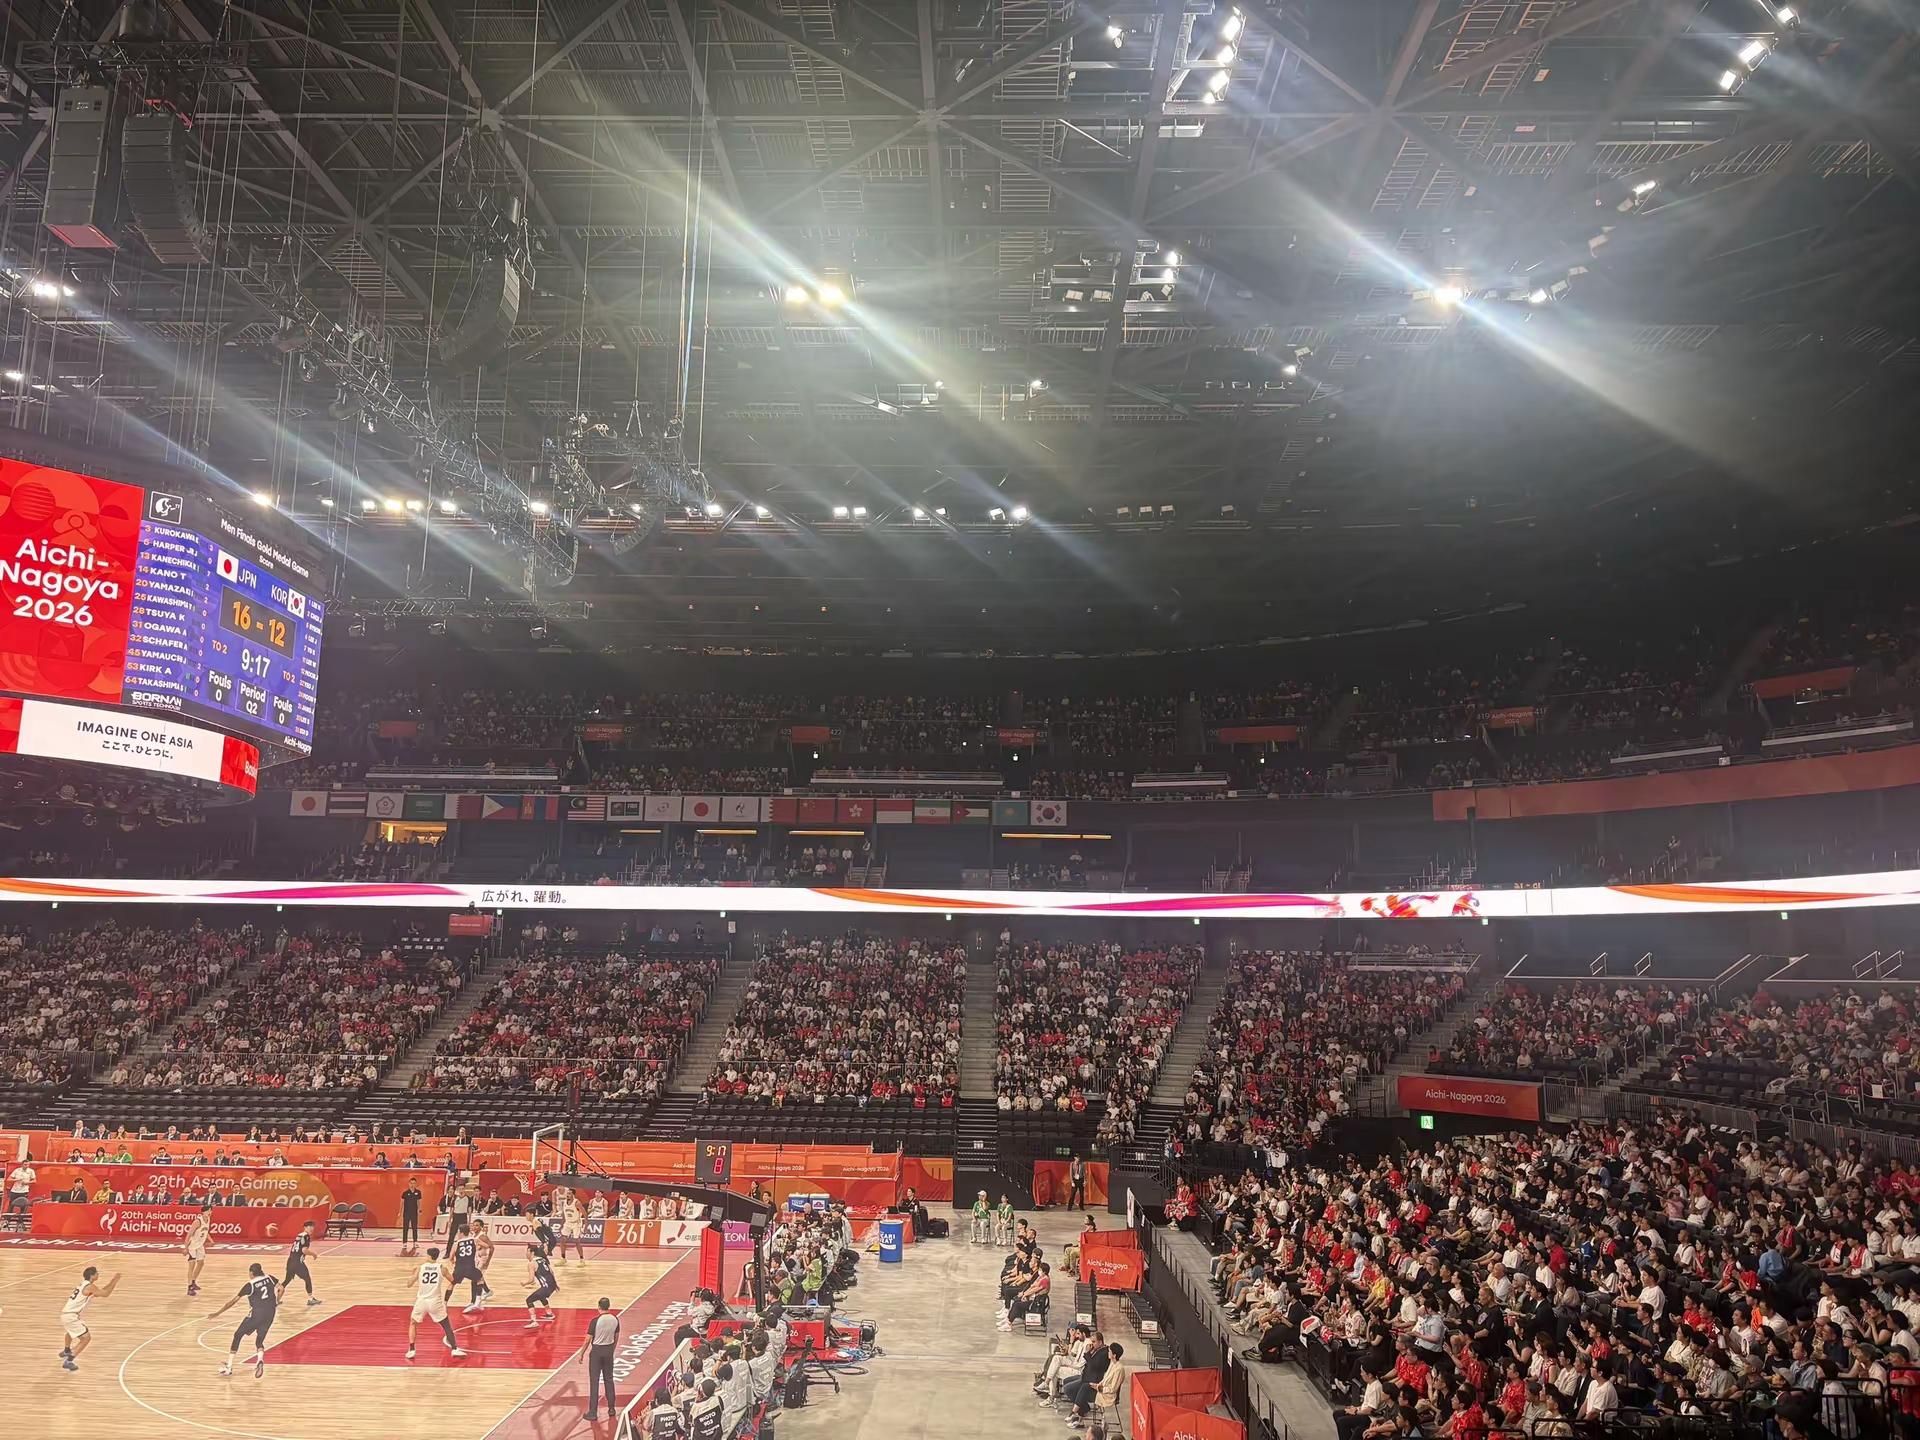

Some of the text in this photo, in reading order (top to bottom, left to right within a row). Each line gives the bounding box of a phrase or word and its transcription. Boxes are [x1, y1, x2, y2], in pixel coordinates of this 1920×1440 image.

[153, 540, 185, 552] HARPER
[220, 519, 236, 536] Men
[236, 528, 256, 547] Finals
[256, 540, 272, 556] Gold
[272, 550, 291, 567] Medal
[15, 538, 109, 571] Aichi-
[150, 567, 178, 578] KANO
[0, 560, 119, 601] Nagoya
[239, 568, 288, 605] JPN KOR
[13, 595, 93, 626] 2026
[145, 609, 177, 620] TSUYA
[144, 622, 181, 635] OGAWA
[233, 601, 251, 630] 16
[269, 619, 286, 648] 12
[142, 636, 183, 649] SCHAFER
[139, 664, 162, 674] KIRK
[165, 667, 172, 675] A
[241, 648, 270, 678] 9:17
[209, 670, 232, 689] Fouls
[215, 689, 222, 701] 0
[240, 682, 266, 703] Period
[273, 696, 293, 713] Fouls
[279, 712, 284, 724] 0
[77, 721, 194, 750] IMAGINE ONE ASIA
[481, 890, 567, 904] 広がれ、躍動。
[1425, 1089, 1506, 1105] Aichi-Nagoya 2026
[706, 1145, 726, 1156] 9:17
[713, 1157, 724, 1174] 8
[148, 1175, 298, 1190] 20th Asian Games
[121, 1211, 143, 1220] 20th
[145, 1212, 172, 1220] Asian
[120, 1222, 241, 1236] Aichi-Nago 2026
[495, 1224, 536, 1234] TOYOT
[459, 1245, 473, 1257] 33
[1087, 1259, 1128, 1271] Aichi-Nagoya
[422, 1272, 438, 1284] 32
[260, 1286, 269, 1300] 2
